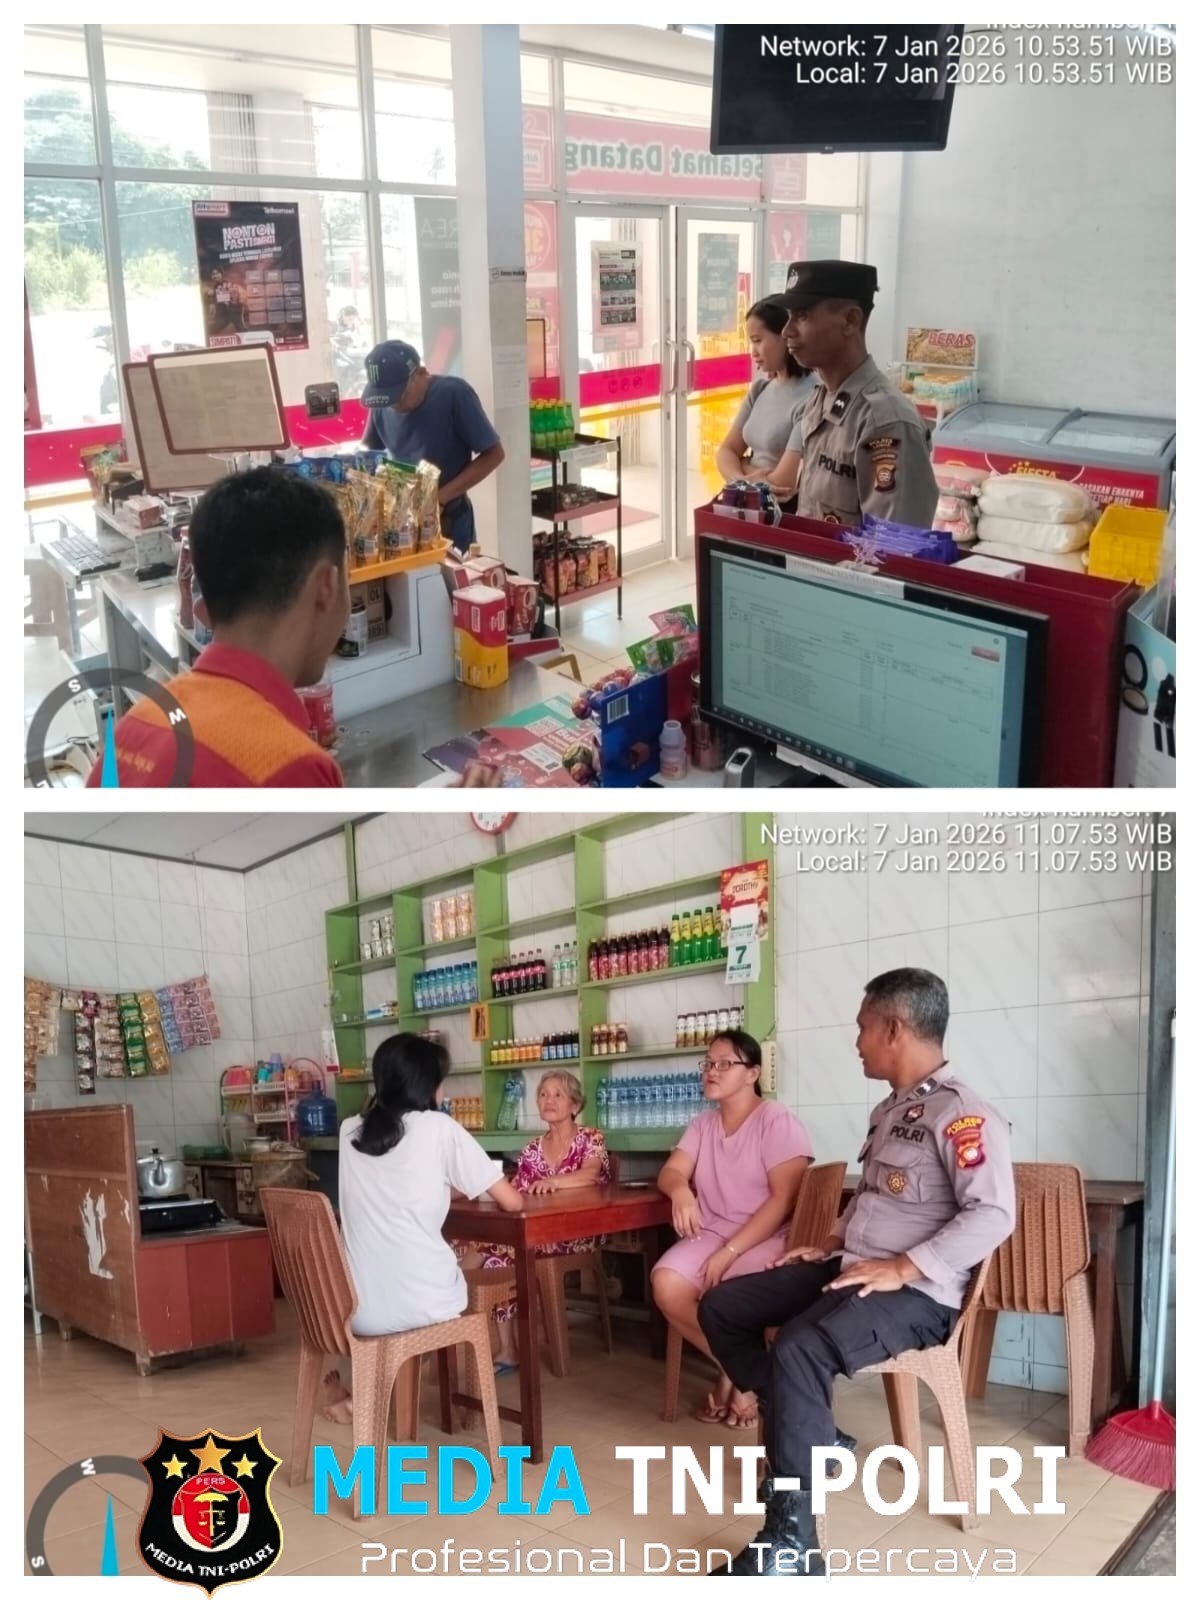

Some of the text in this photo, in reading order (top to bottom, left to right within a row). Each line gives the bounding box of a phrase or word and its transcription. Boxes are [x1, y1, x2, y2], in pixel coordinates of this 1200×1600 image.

[222, 222, 276, 241] NONTON
[223, 237, 253, 252] PASTI
[927, 332, 975, 347] BERAS
[818, 454, 857, 479] POLRI
[735, 945, 747, 964] 7
[890, 1125, 925, 1143] POLRI
